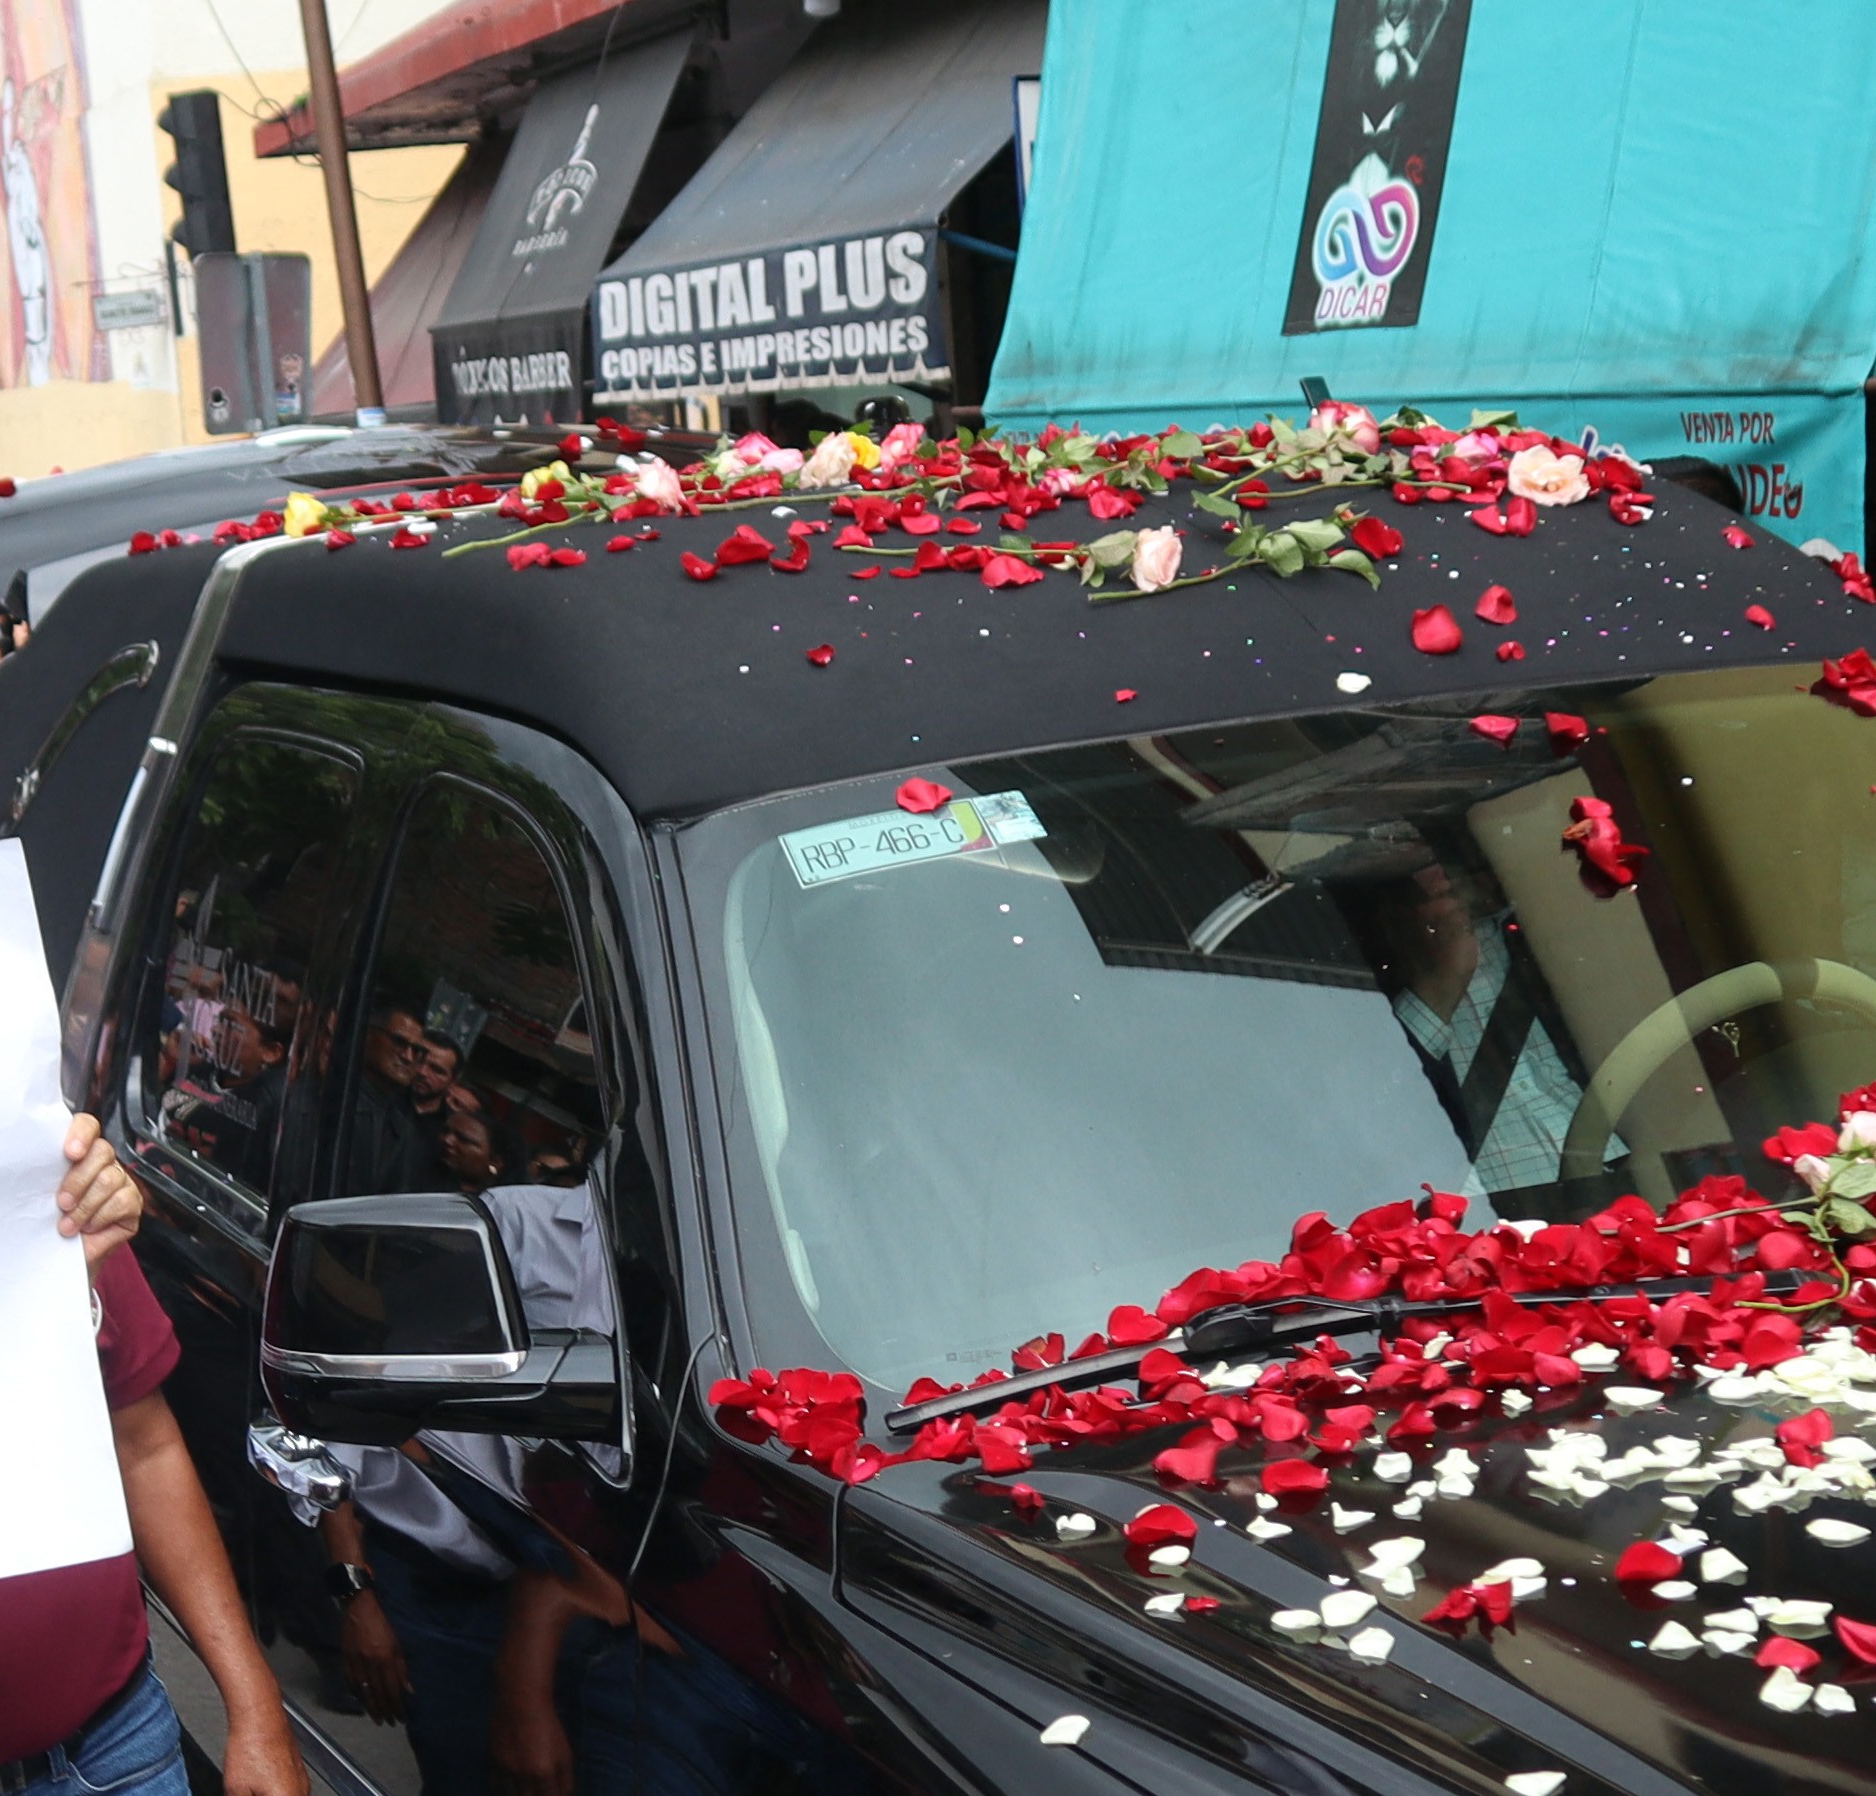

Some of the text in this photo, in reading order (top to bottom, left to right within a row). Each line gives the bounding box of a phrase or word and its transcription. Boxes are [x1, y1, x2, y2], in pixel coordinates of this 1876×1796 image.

[599, 231, 928, 341] DIGITAL PLUS
[1317, 282, 1389, 320] DICAR
[510, 351, 573, 392] BARBER
[601, 315, 930, 381] COPIAS E IMPRESIONES
[1680, 411, 1776, 444] VENTA POR
[799, 817, 965, 874] RBP-466-C
